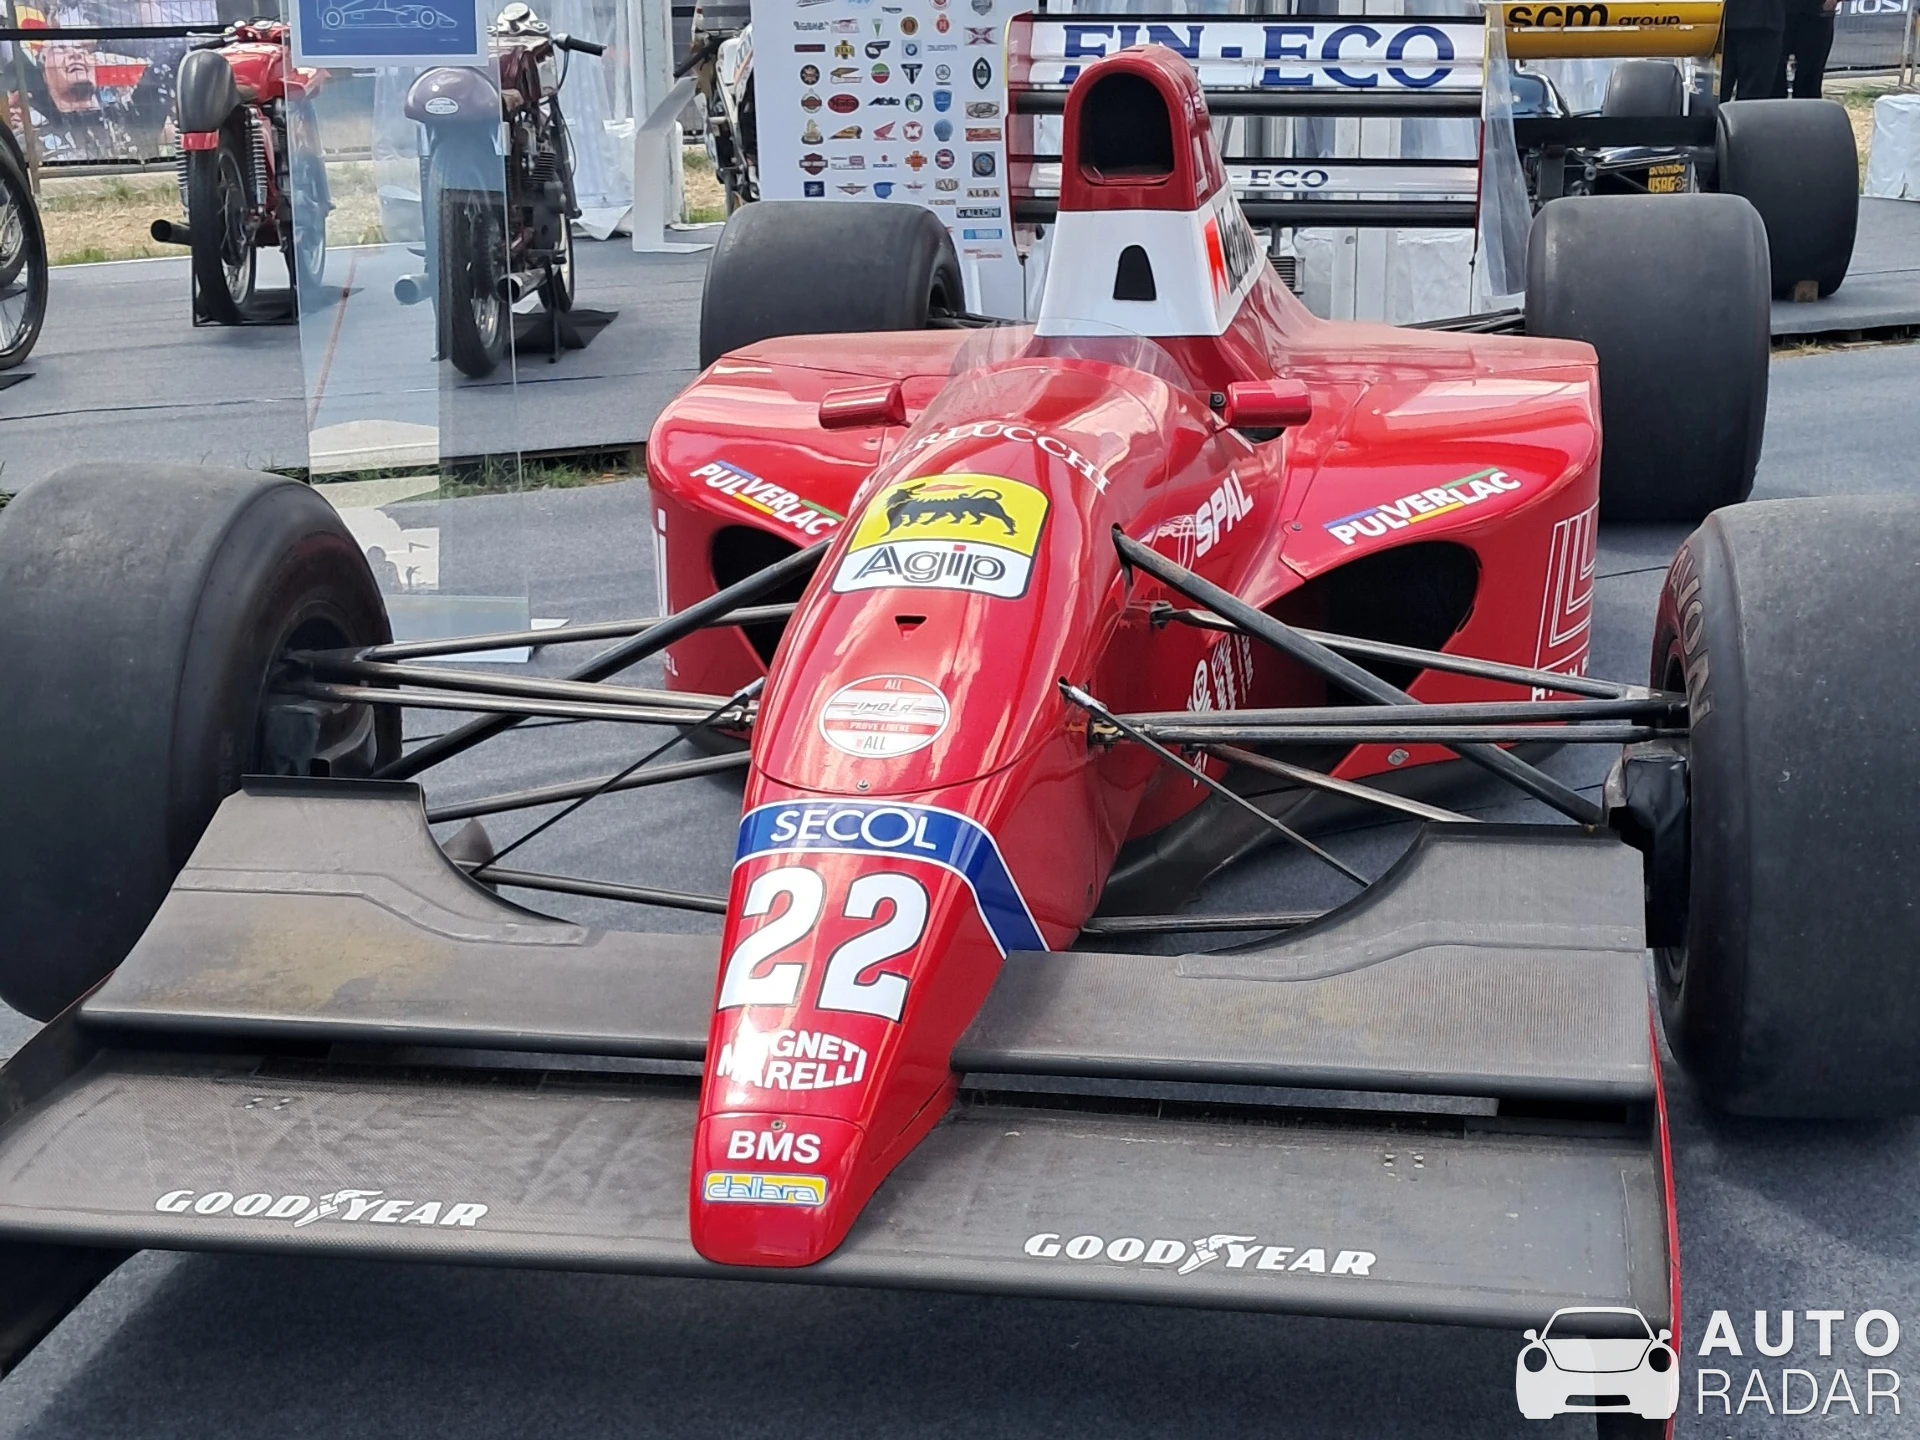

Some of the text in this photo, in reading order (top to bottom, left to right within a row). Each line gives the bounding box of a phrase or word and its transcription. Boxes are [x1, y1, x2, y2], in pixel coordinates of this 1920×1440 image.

[1508, 4, 1681, 27] scm group
[967, 189, 1000, 198] ALBA
[1648, 176, 1676, 193] USAG
[689, 461, 836, 537] PULVERLAC
[1196, 468, 1254, 558] SPAL
[1328, 471, 1521, 546] PULVERLAC
[852, 544, 1006, 586] Agip
[884, 679, 903, 690] ALL
[863, 735, 886, 750] ALL
[770, 806, 937, 850] SECOL
[716, 866, 930, 1023] 22
[717, 1029, 868, 1077] MGNETI
[727, 1130, 821, 1164] BMS
[155, 1190, 488, 1228] GOODYEAR
[708, 1176, 820, 1203] dallara
[1024, 1233, 1377, 1276] GOODYEAR
